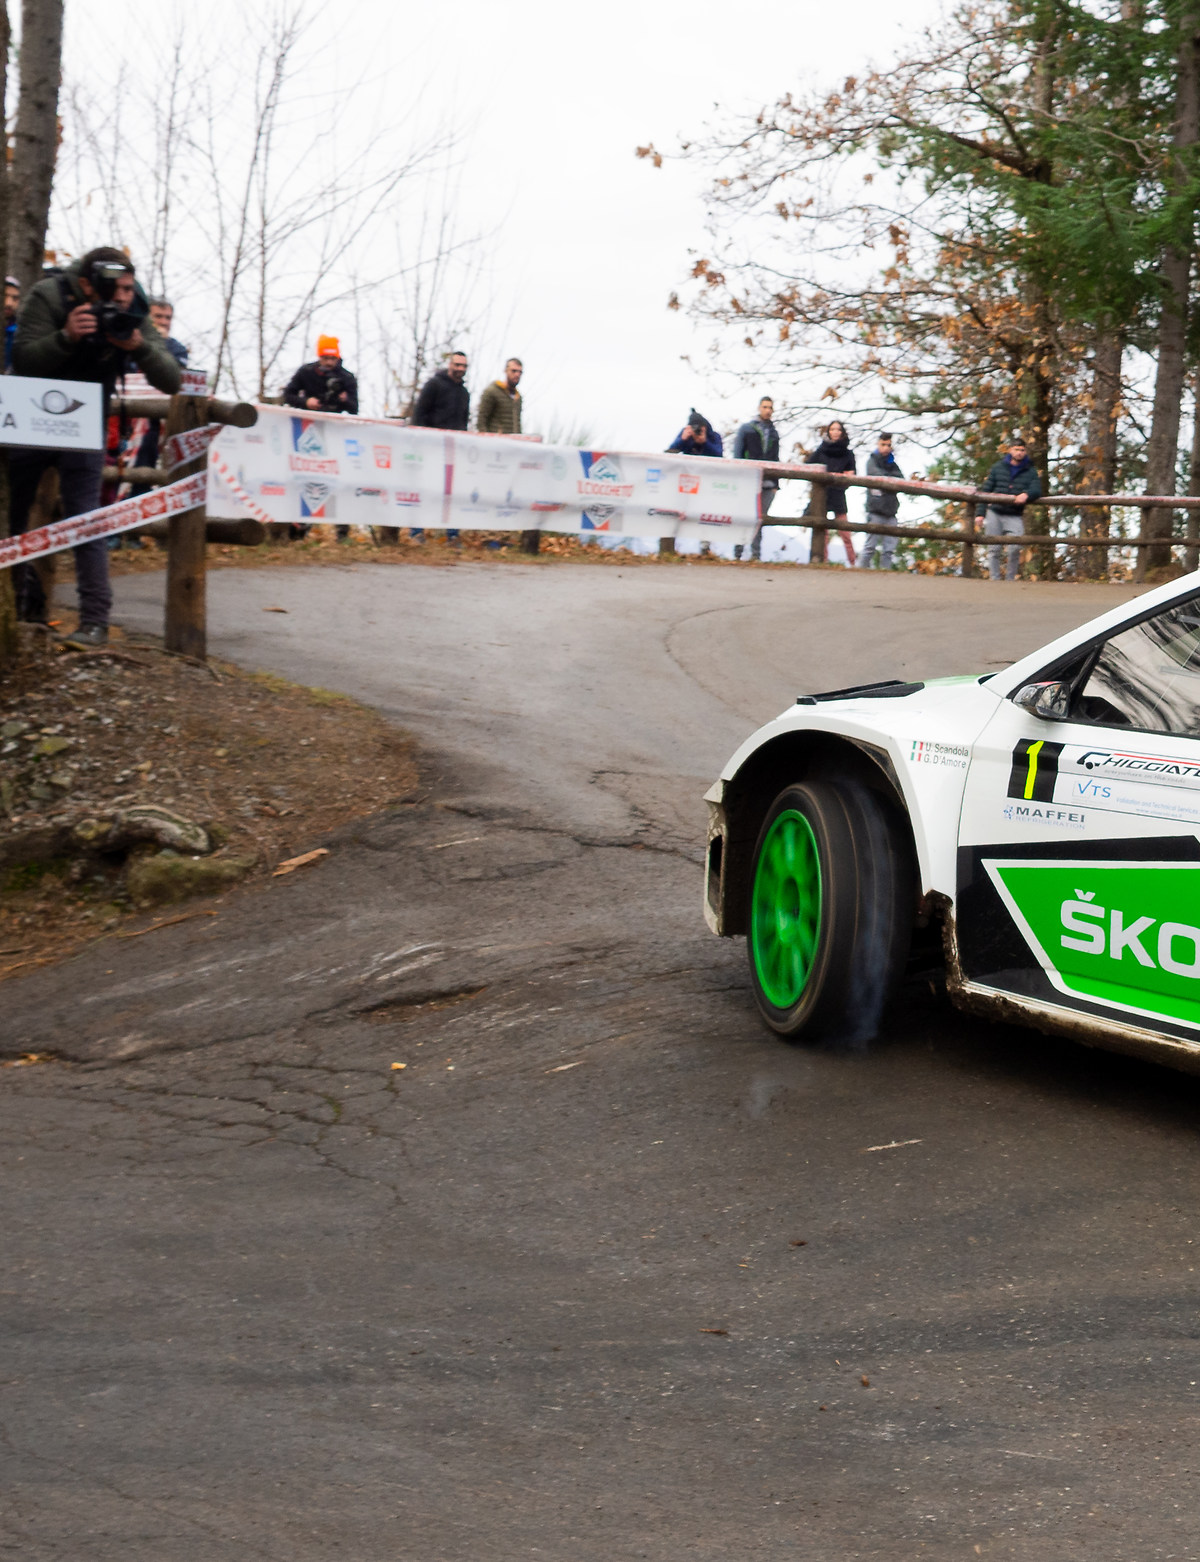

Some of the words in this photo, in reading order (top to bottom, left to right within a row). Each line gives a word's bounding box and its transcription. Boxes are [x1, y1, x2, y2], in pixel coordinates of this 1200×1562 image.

[934, 743, 969, 757] Scandola
[1023, 740, 1044, 800] 1
[1016, 806, 1085, 823] MAFFEI
